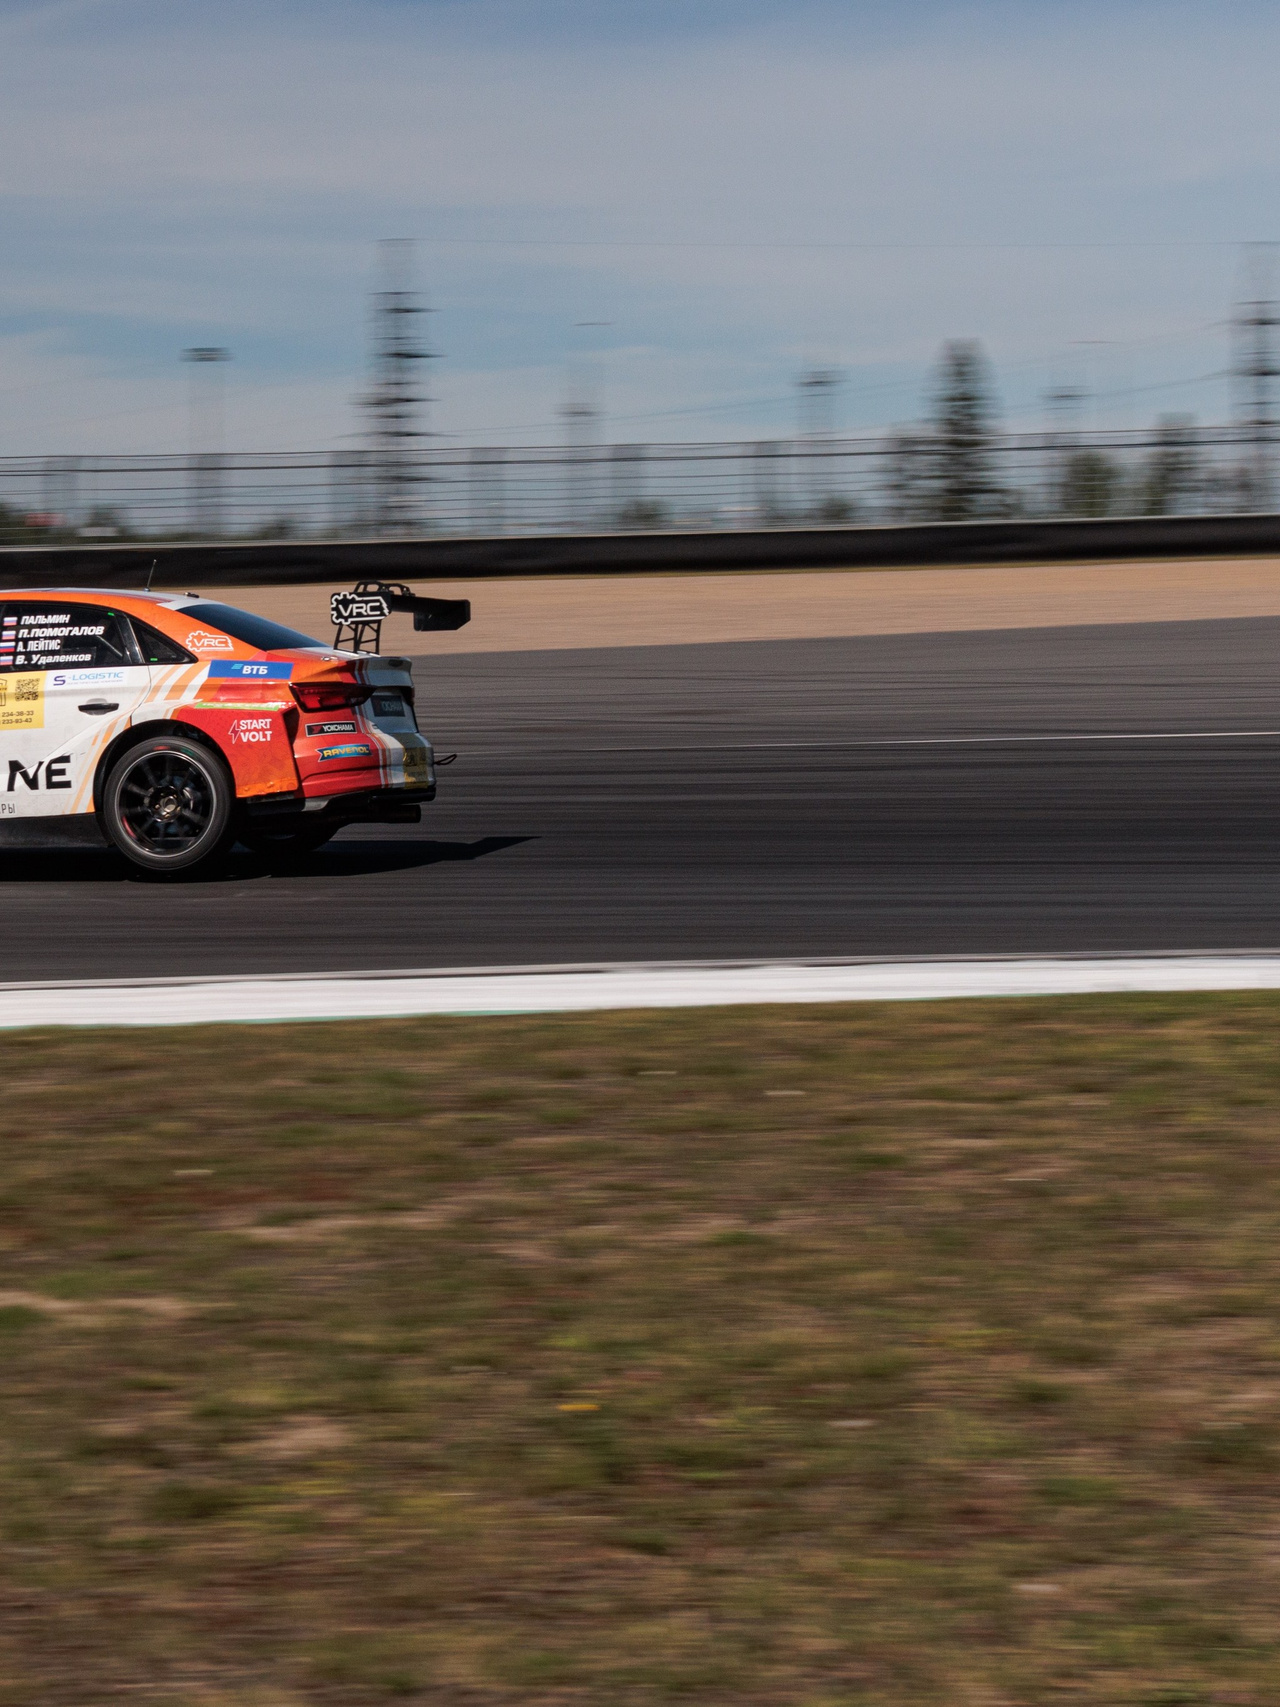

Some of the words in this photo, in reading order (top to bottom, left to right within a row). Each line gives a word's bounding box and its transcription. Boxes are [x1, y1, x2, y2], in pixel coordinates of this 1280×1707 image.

[339, 602, 381, 617] VRC
[21, 614, 71, 625] ПАЛЬМИН
[18, 626, 105, 638] П.ПОМОГАЛОВ
[16, 641, 26, 652] А.
[27, 639, 61, 652] ЛЕЙТИС
[193, 637, 228, 648] VRC
[15, 655, 28, 665] В.
[31, 653, 92, 665] Удаленков
[242, 664, 268, 675] ВТБ
[240, 718, 272, 730] START
[241, 731, 272, 742] VOLT
[323, 746, 370, 757] RAVENOL
